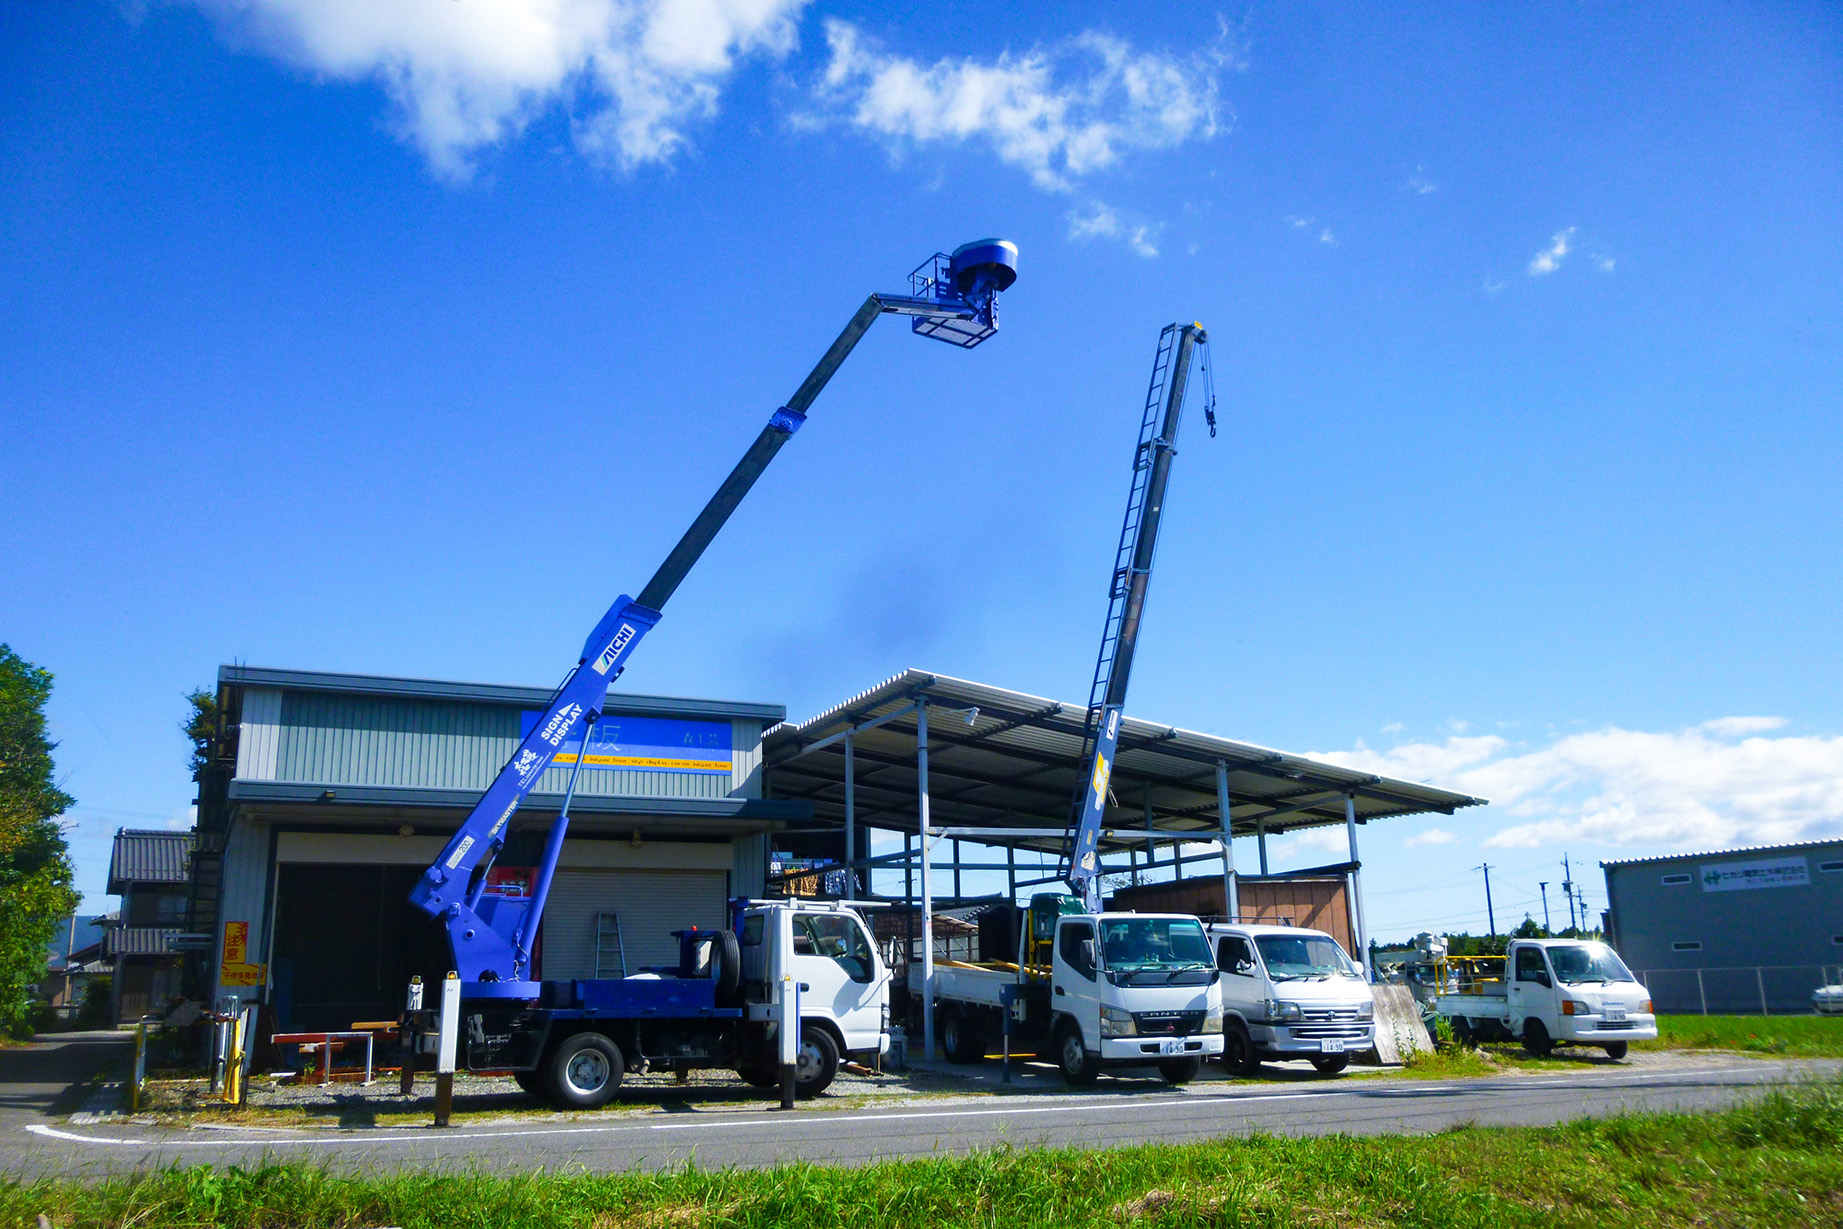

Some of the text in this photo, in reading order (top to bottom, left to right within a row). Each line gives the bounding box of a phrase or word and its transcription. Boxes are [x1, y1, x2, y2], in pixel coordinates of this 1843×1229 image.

[603, 627, 633, 666] AICHI
[541, 714, 563, 740] SIGN
[549, 704, 582, 747] DISPLAY
[491, 800, 518, 835] SKYMASTER
[459, 840, 471, 853] 200
[225, 934, 241, 960] 注意
